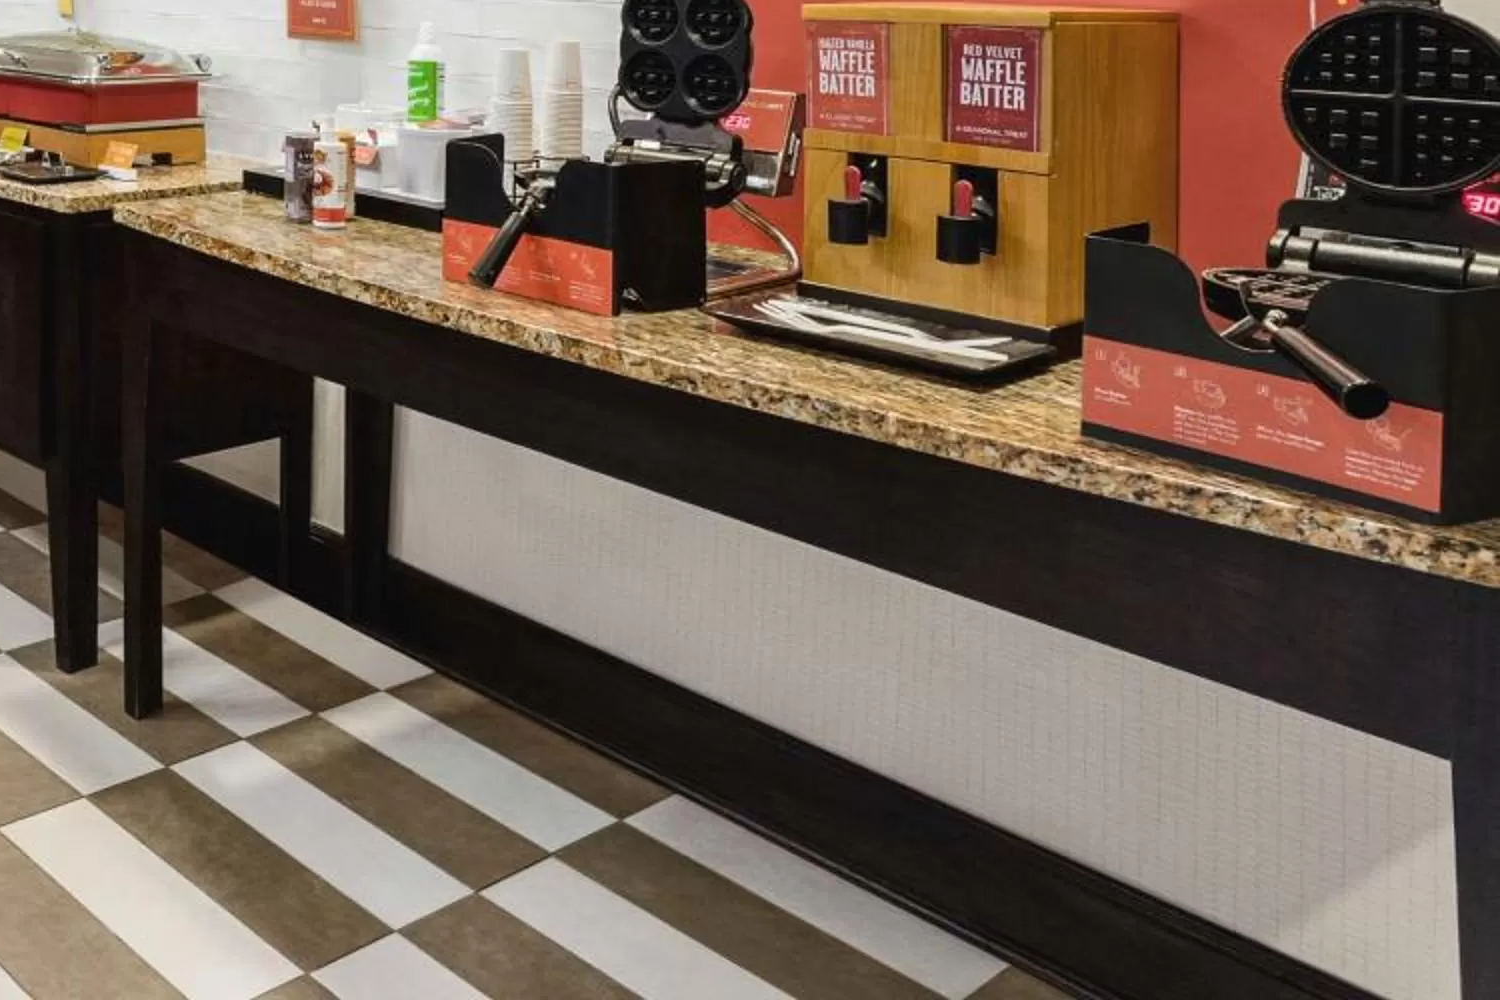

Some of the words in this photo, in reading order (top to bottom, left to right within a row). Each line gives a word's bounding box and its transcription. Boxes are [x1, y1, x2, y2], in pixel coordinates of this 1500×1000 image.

[819, 49, 876, 74] WAFFLE
[963, 43, 983, 57] RED
[985, 45, 1022, 60] VELVET
[961, 56, 1027, 85] WAFFLE
[819, 71, 876, 97] BATTER
[960, 81, 1026, 111] BATTER
